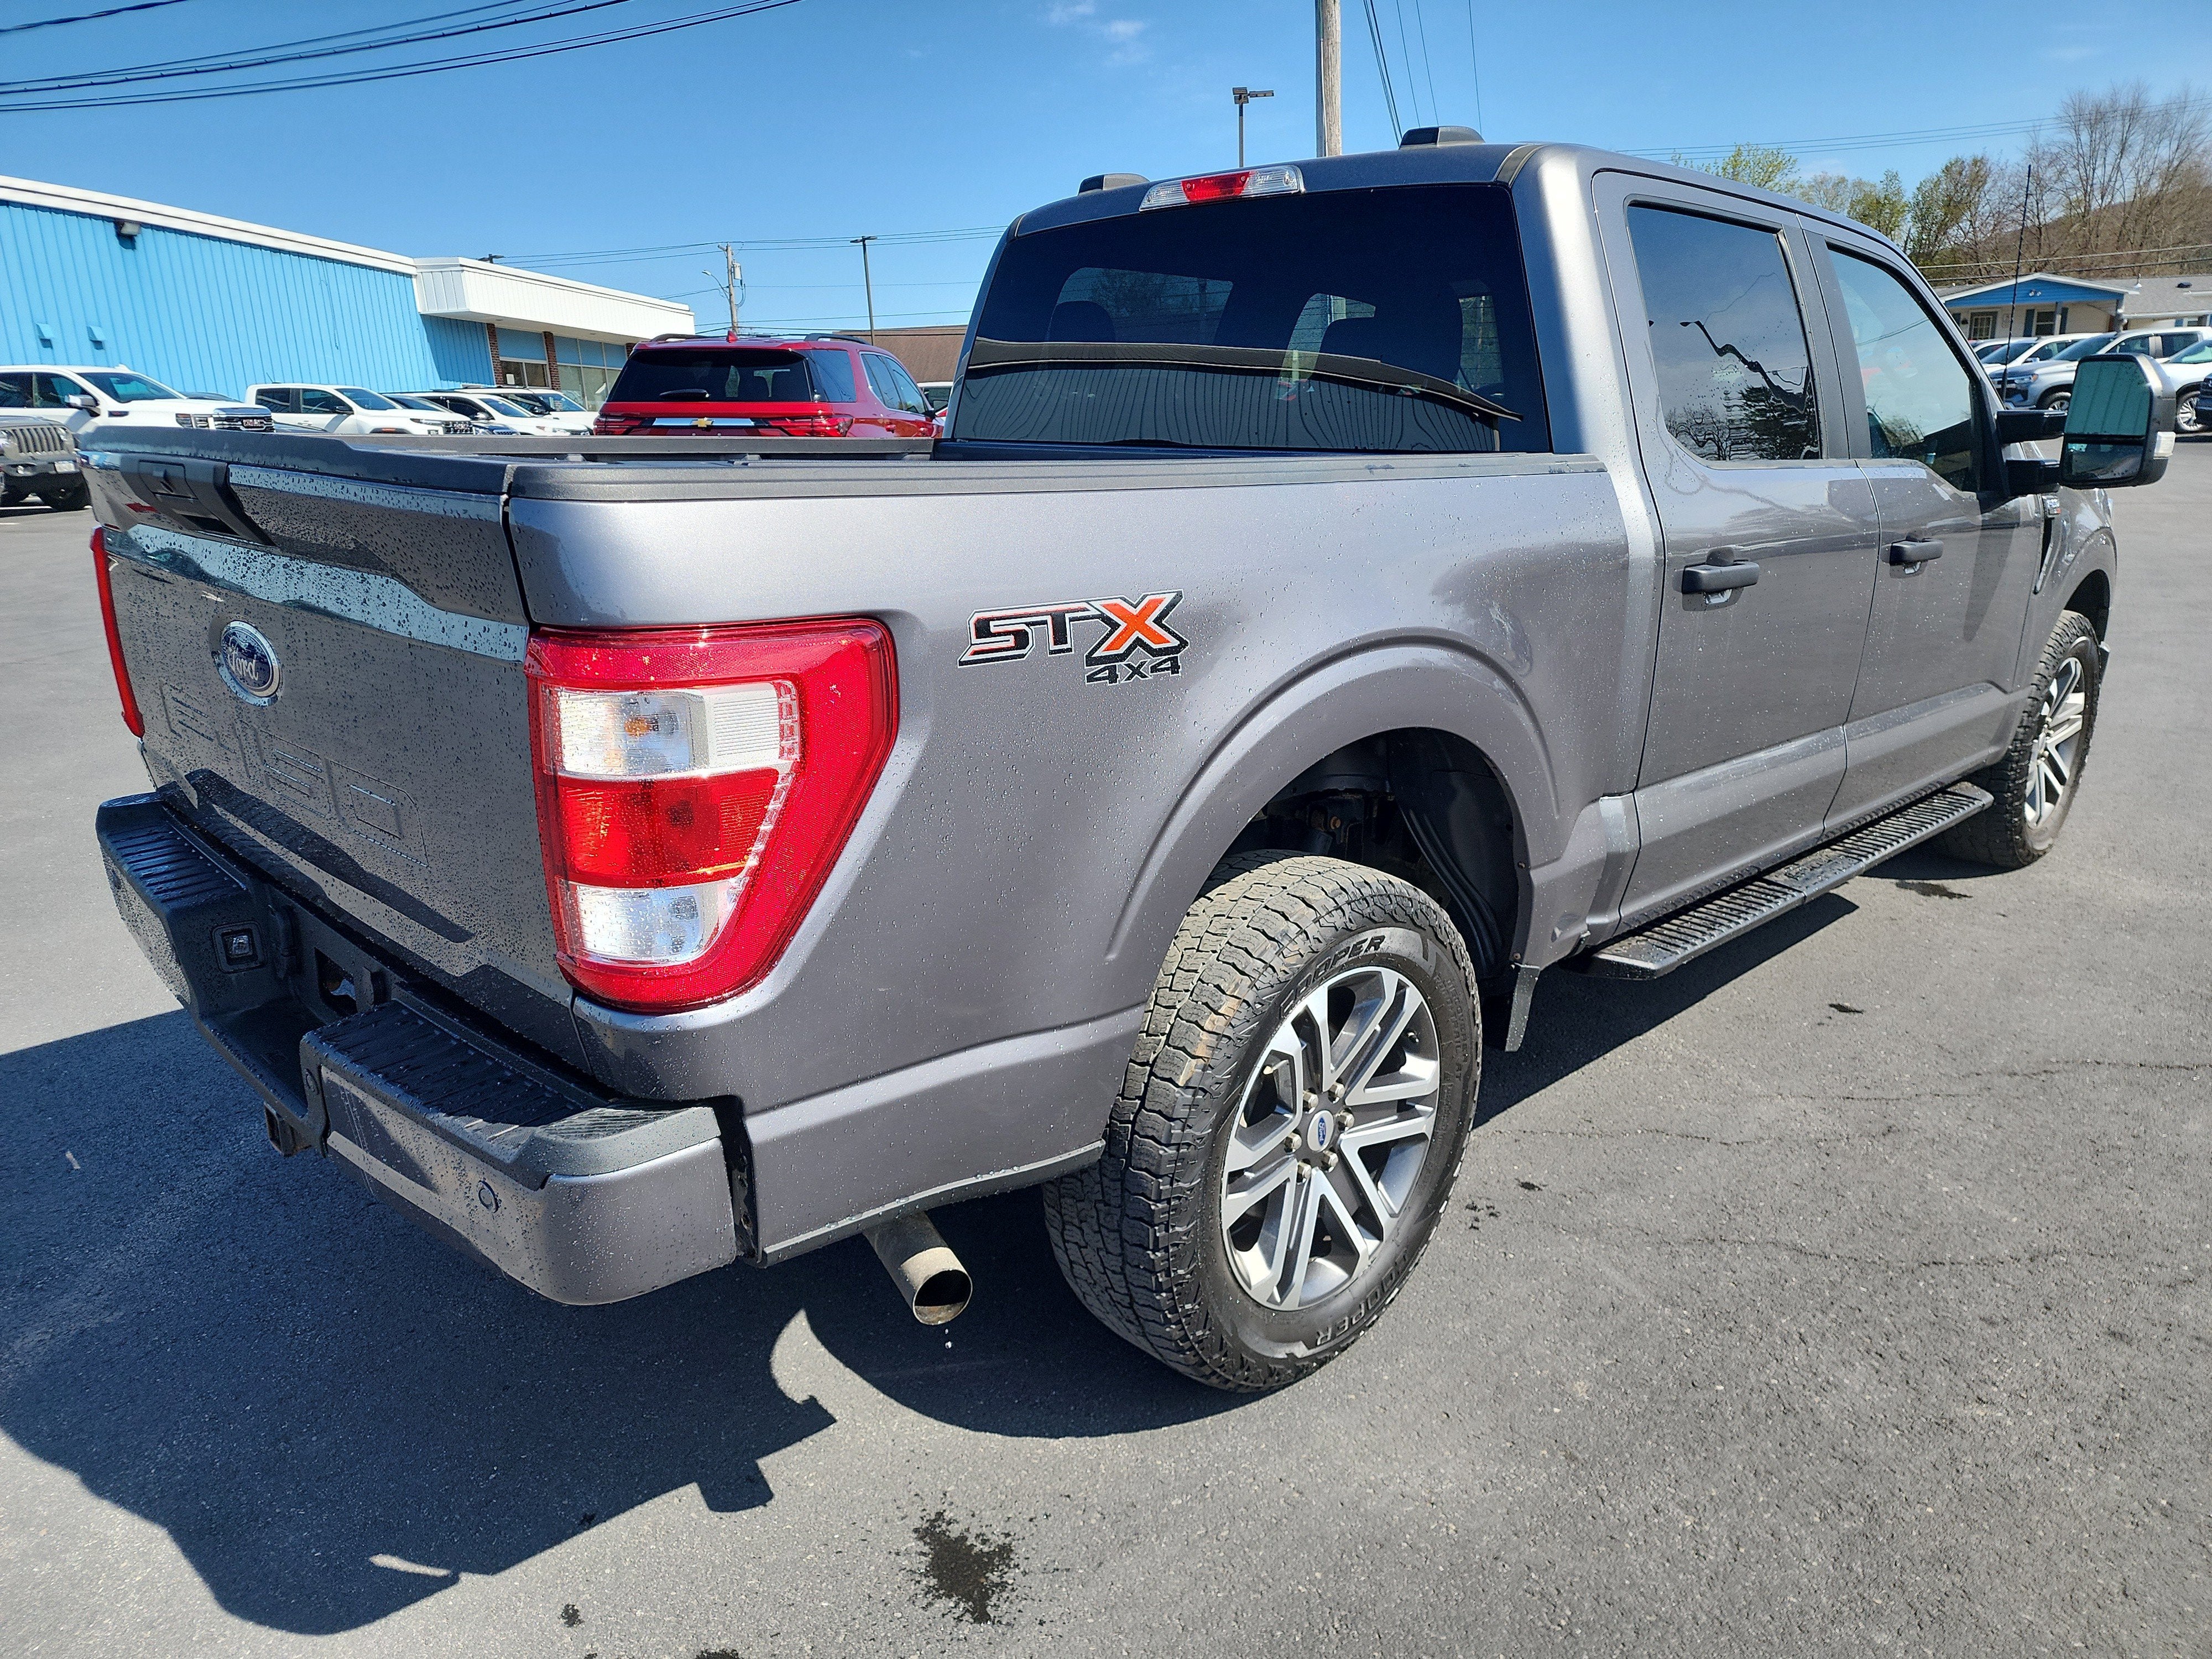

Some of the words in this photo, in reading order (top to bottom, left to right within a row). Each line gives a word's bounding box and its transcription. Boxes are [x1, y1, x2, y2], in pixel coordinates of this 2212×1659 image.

[227, 635, 259, 681] Ford
[957, 589, 1190, 668] STX
[1279, 935, 1386, 1021] COOPER
[1316, 1247, 1409, 1345] COOPER
